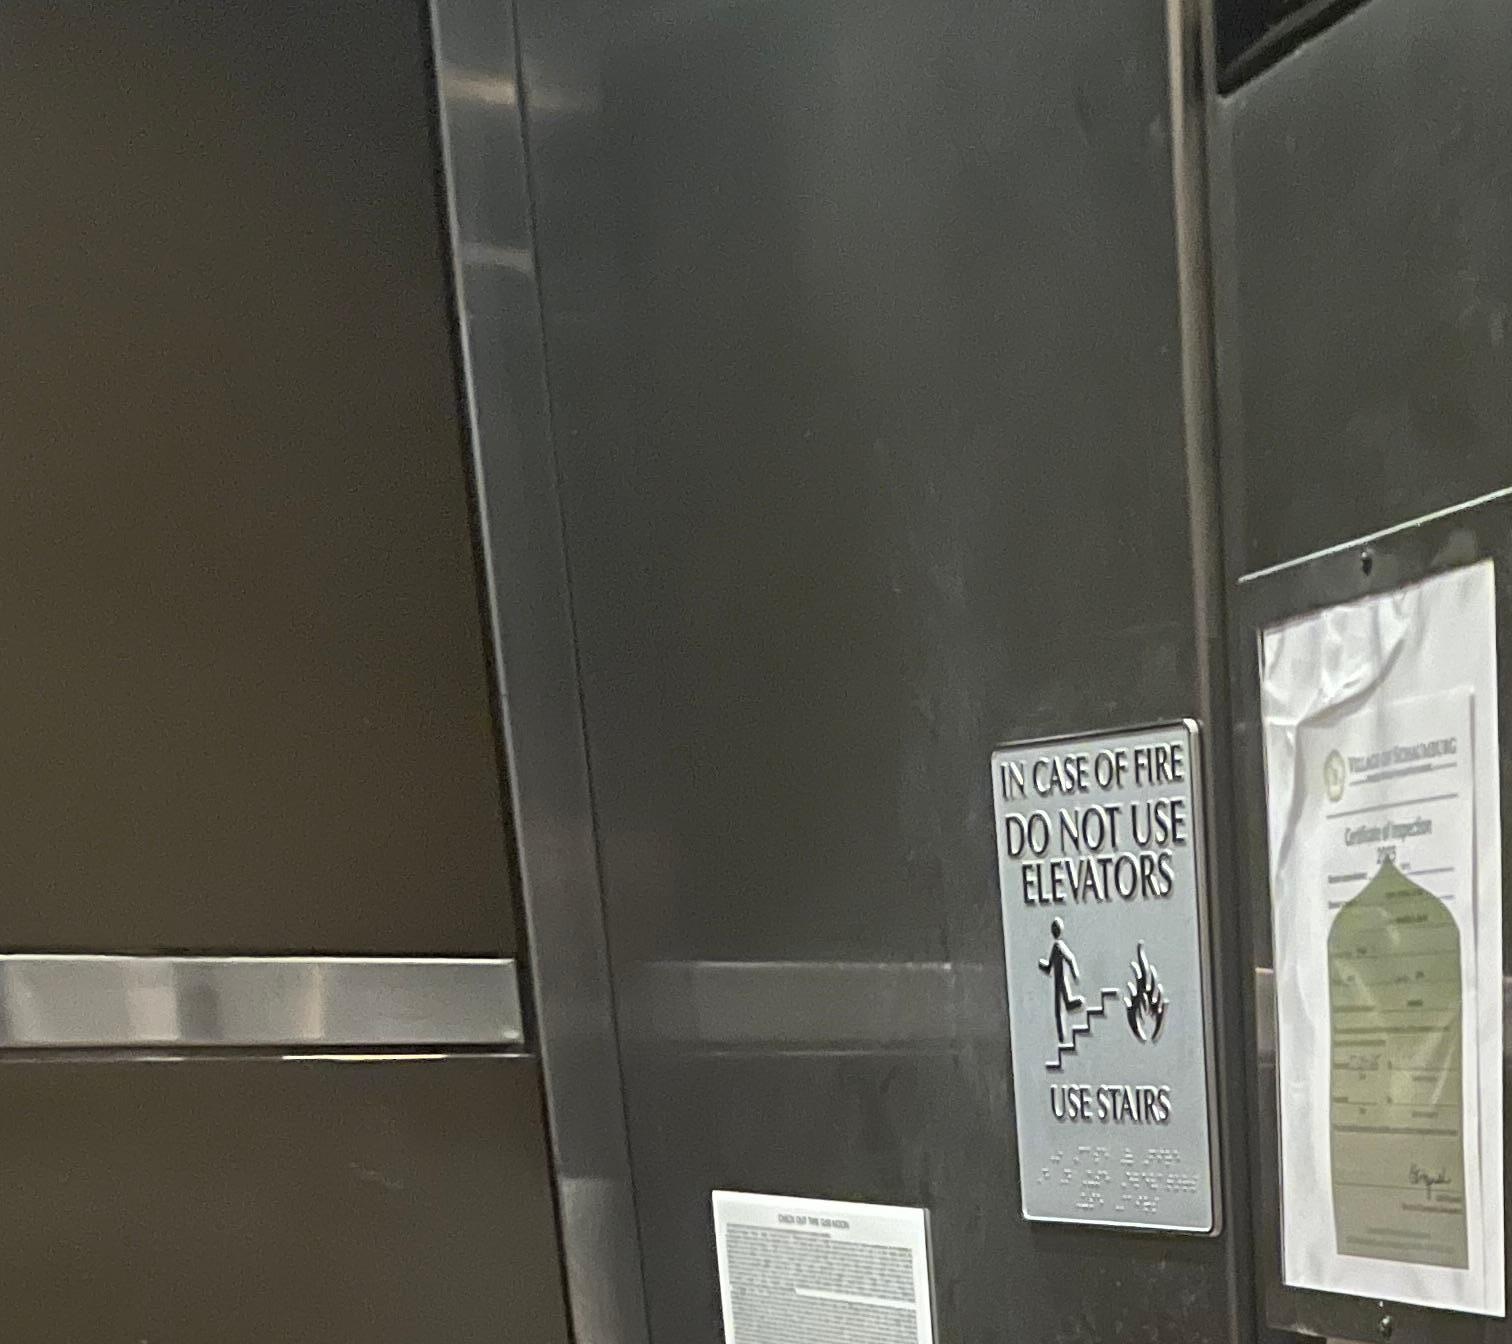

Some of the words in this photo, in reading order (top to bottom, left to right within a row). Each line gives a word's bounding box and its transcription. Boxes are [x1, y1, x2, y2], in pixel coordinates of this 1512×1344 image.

[1000, 761, 1026, 799] IN
[1033, 753, 1089, 794] CASE
[1094, 748, 1128, 789] OF
[1134, 741, 1185, 785] FIRE
[1005, 810, 1052, 858] DO
[1059, 803, 1124, 855] NOT
[1131, 796, 1186, 847] USE
[1021, 849, 1175, 905] ELEVATORS
[1050, 1084, 1092, 1123] USE
[1097, 1084, 1171, 1126] STAIRS
